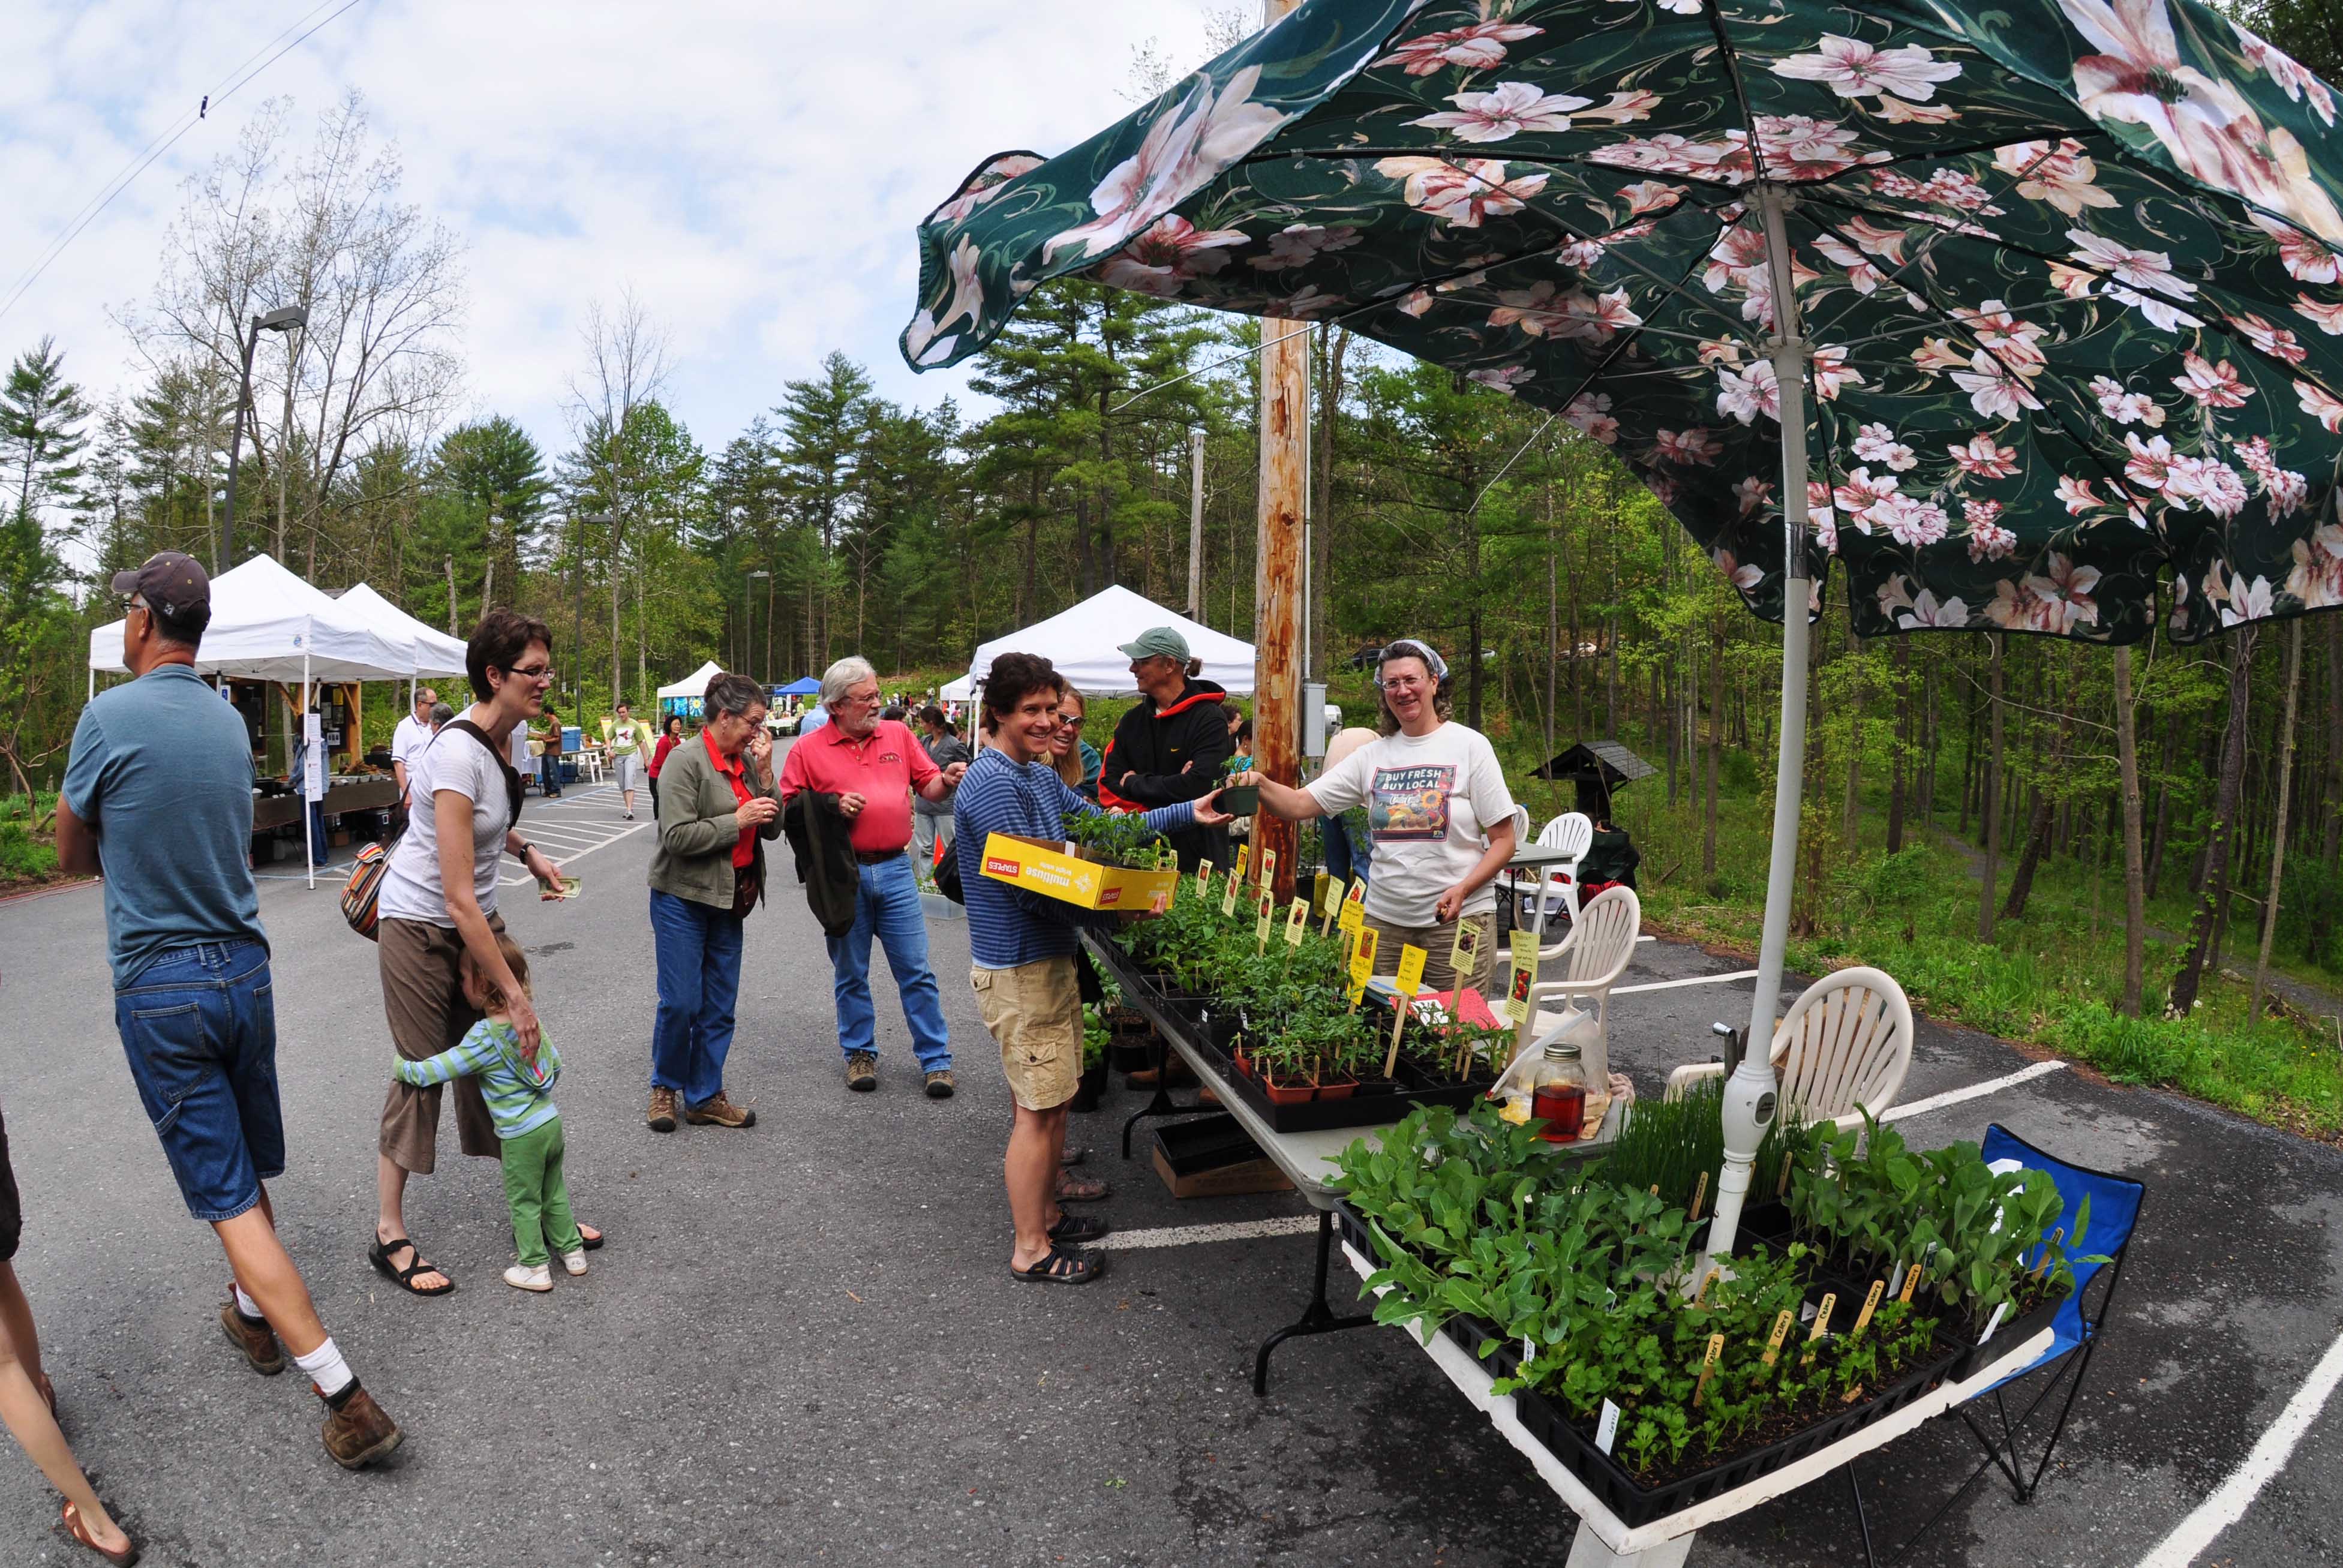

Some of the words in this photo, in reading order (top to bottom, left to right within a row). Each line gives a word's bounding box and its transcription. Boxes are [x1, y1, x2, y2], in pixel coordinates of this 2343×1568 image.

[1386, 771, 1406, 782] BUY
[1408, 769, 1442, 779] FRESH
[1406, 780, 1440, 790] LOCAL
[988, 861, 1017, 873] STAPLES
[1026, 867, 1070, 887] multiuse
[1101, 891, 1119, 901] STAPLES
[1905, 1269, 1918, 1290] Celery
[1867, 1285, 1882, 1306] Celery
[1819, 1296, 1833, 1319] Celery
[1774, 1315, 1789, 1338] Celery
[1707, 1341, 1720, 1364] Celery
